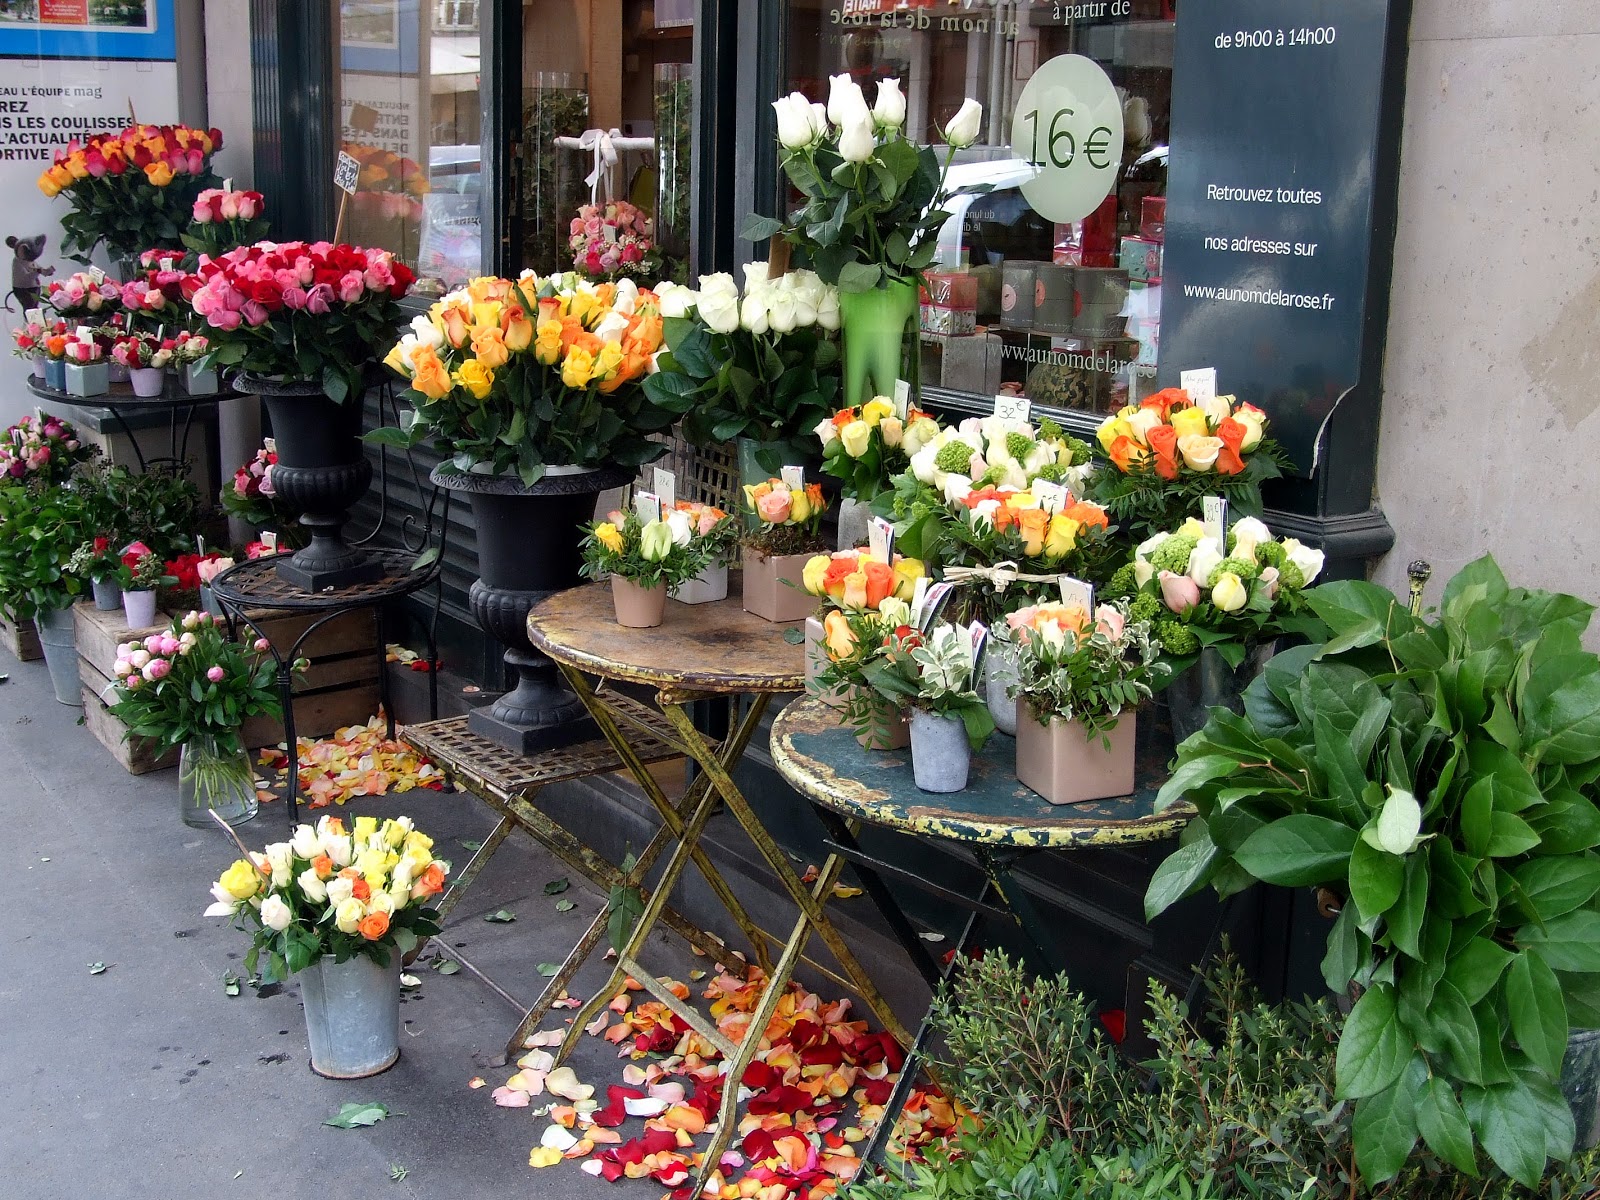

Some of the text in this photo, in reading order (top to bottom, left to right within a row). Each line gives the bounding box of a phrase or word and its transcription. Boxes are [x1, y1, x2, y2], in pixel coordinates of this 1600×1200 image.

[1052, 0, 1131, 26] à partir de
[1214, 26, 1336, 49] de 9h00 à 14h00
[22, 85, 71, 97] L'ÉQUIPE
[74, 86, 103, 99] mag
[0, 101, 29, 113] REZ
[0, 117, 133, 129] S LES COULISSES
[1207, 184, 1322, 205] Retrouvez toutes
[1204, 235, 1317, 257] nos adresses sur
[1184, 284, 1335, 311] www.aunomdelarose.fr
